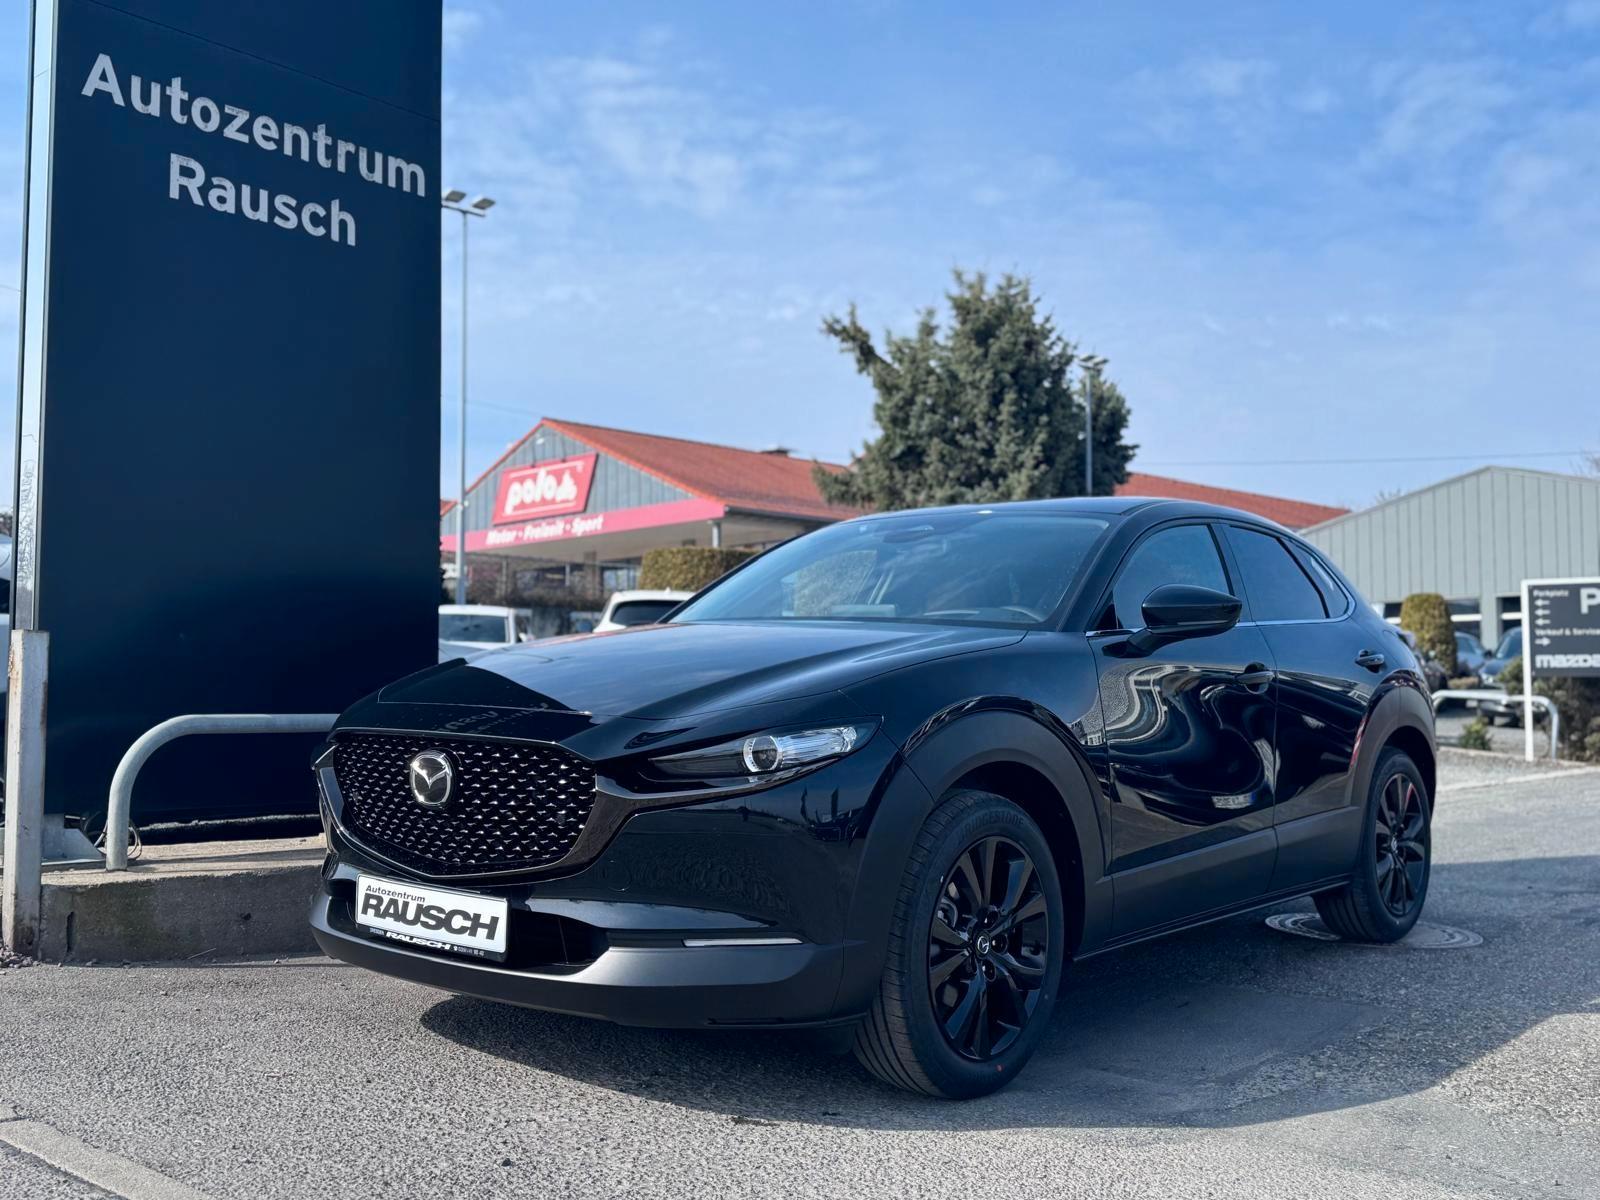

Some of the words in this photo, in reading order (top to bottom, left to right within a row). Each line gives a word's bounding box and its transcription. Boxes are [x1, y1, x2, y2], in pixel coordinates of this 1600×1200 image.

[81, 53, 426, 198] Autozentrum
[168, 152, 357, 247] Rausch
[503, 467, 557, 515] polo
[571, 514, 604, 537] Sport
[360, 893, 500, 941] RAUSCH
[365, 884, 426, 903] Autozentrum
[385, 931, 451, 951] RAUSCH
